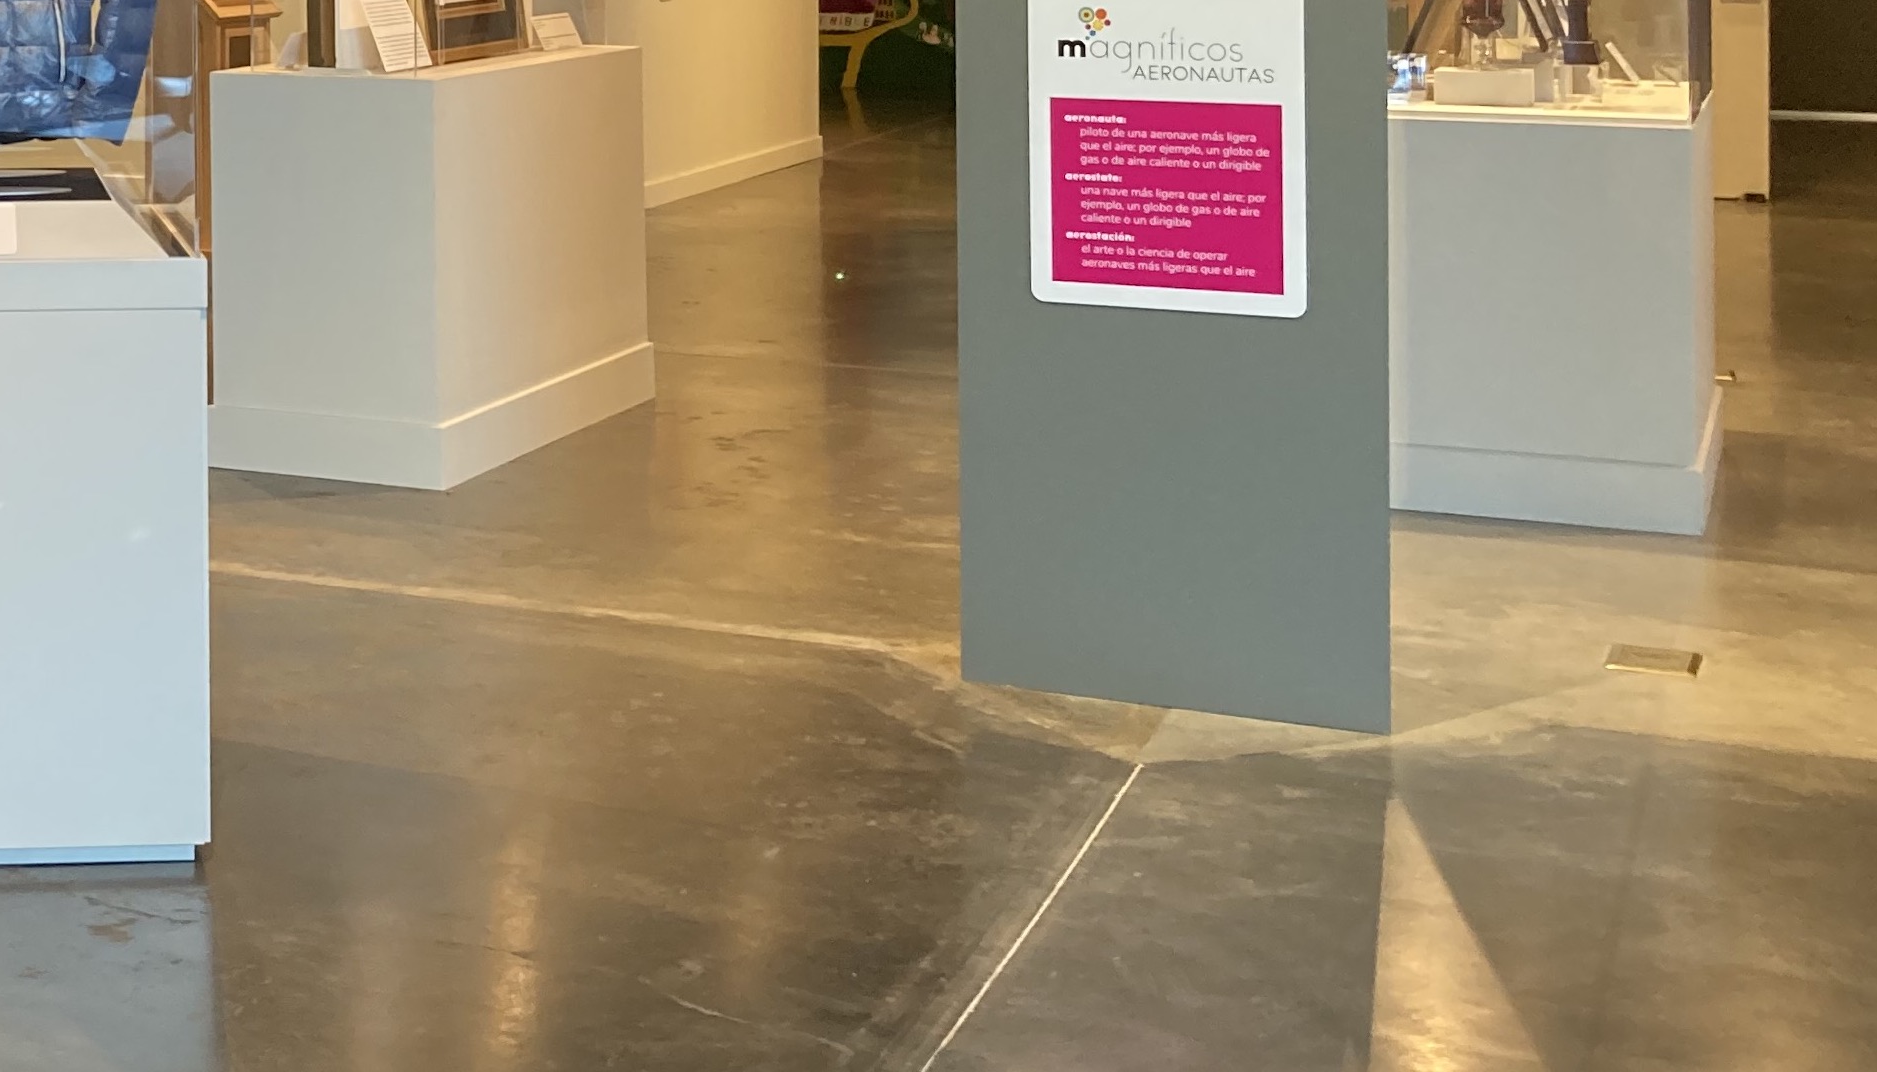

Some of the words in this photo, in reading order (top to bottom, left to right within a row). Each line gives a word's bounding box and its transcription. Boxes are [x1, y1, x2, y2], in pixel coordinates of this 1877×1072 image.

[1058, 27, 1244, 73] magníficos
[1132, 64, 1275, 84] AERONAUTAS
[1064, 114, 1127, 124] aeronauta:
[1079, 126, 1110, 138] piloto
[1111, 127, 1125, 138] de
[1127, 129, 1148, 139] una
[1150, 130, 1199, 141] aeronave
[1201, 130, 1224, 142] más
[1226, 131, 1257, 144] ligera
[1080, 142, 1100, 152] que
[1102, 141, 1112, 150] el
[1114, 142, 1136, 152] aire;
[1138, 143, 1157, 154] por
[1159, 144, 1204, 156] ejemplo,
[1206, 147, 1220, 156] un
[1222, 146, 1254, 158] globo
[1255, 147, 1270, 158] de
[1080, 156, 1099, 166] gas
[1101, 156, 1109, 165] o
[1111, 155, 1125, 166] de
[1127, 156, 1147, 167] aire
[1149, 157, 1190, 168] caliente
[1192, 160, 1200, 169] o
[1202, 160, 1216, 169] un
[1218, 159, 1262, 173] dirigible
[1064, 172, 1123, 183] aerostato:
[1080, 186, 1101, 195] una
[1102, 187, 1129, 197] nave
[1130, 186, 1154, 198] más
[1155, 188, 1185, 201] ligera
[1187, 192, 1208, 202] que
[1210, 190, 1220, 201] el
[1222, 192, 1246, 203] aire;
[1247, 195, 1267, 205] por
[1080, 199, 1124, 211] ejemplo,
[1127, 202, 1141, 211] un
[1142, 201, 1173, 214] globo
[1175, 203, 1189, 213] de
[1191, 205, 1212, 216] gas
[1213, 206, 1221, 215] o
[1223, 205, 1237, 216] de
[1240, 206, 1260, 217] aire
[1080, 213, 1121, 224] caliente
[1123, 215, 1131, 225] o
[1133, 216, 1147, 225] un
[1149, 216, 1192, 229] dirigible
[1065, 230, 1135, 242] aerostación:
[1081, 243, 1091, 254] el
[1093, 245, 1115, 255] arte
[1116, 246, 1124, 255] o
[1126, 245, 1136, 256] la
[1137, 247, 1174, 258] ciencia
[1176, 248, 1191, 259] de
[1192, 251, 1228, 262] operar
[1081, 259, 1136, 270] aeronaves
[1137, 260, 1160, 272] más
[1162, 262, 1198, 274] ligeras
[1200, 265, 1221, 276] que
[1223, 265, 1233, 276] el
[1235, 266, 1257, 277] aire
